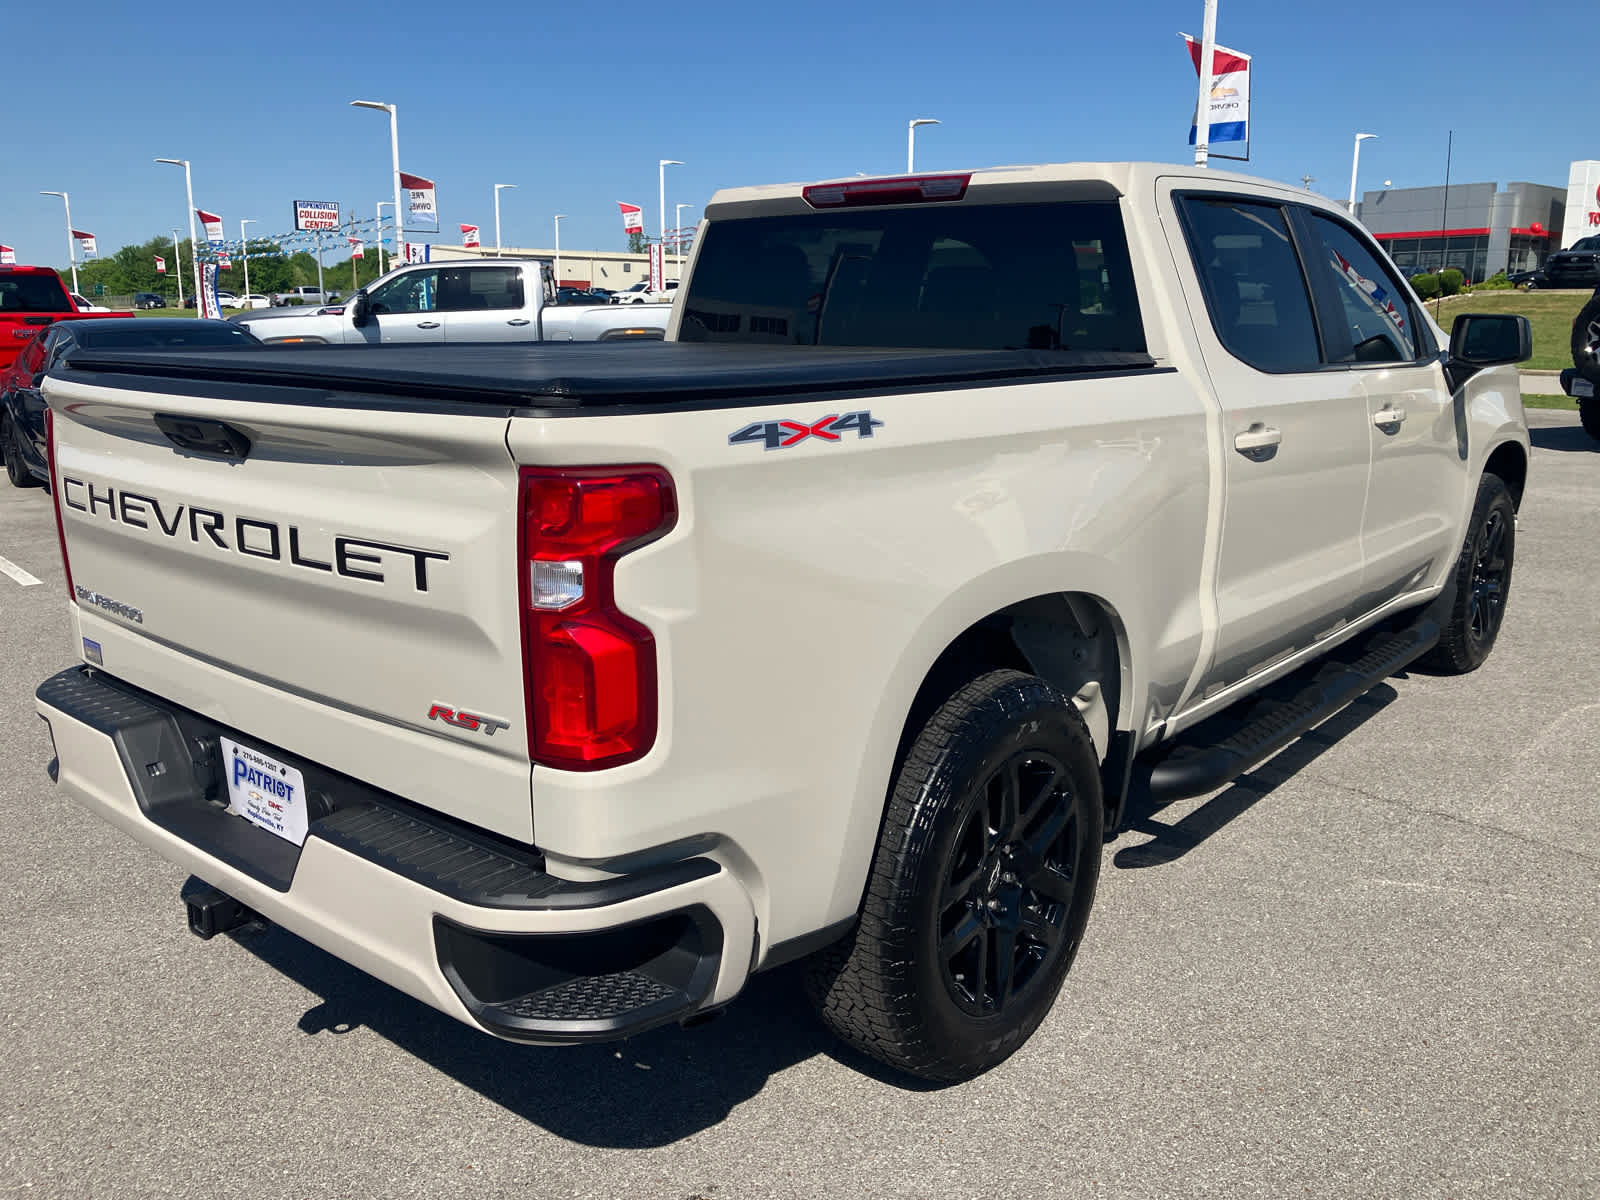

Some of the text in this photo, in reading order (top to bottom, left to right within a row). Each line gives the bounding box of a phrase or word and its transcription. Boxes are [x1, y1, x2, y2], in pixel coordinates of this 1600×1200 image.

[298, 201, 337, 211] HOPKINSVILLE
[299, 210, 337, 220] COLLISION
[304, 220, 333, 230] CENTER
[63, 476, 450, 593] CHEVROLET
[427, 701, 510, 737] RST
[233, 757, 294, 801] PATRIOT
[267, 800, 284, 813] GMC
